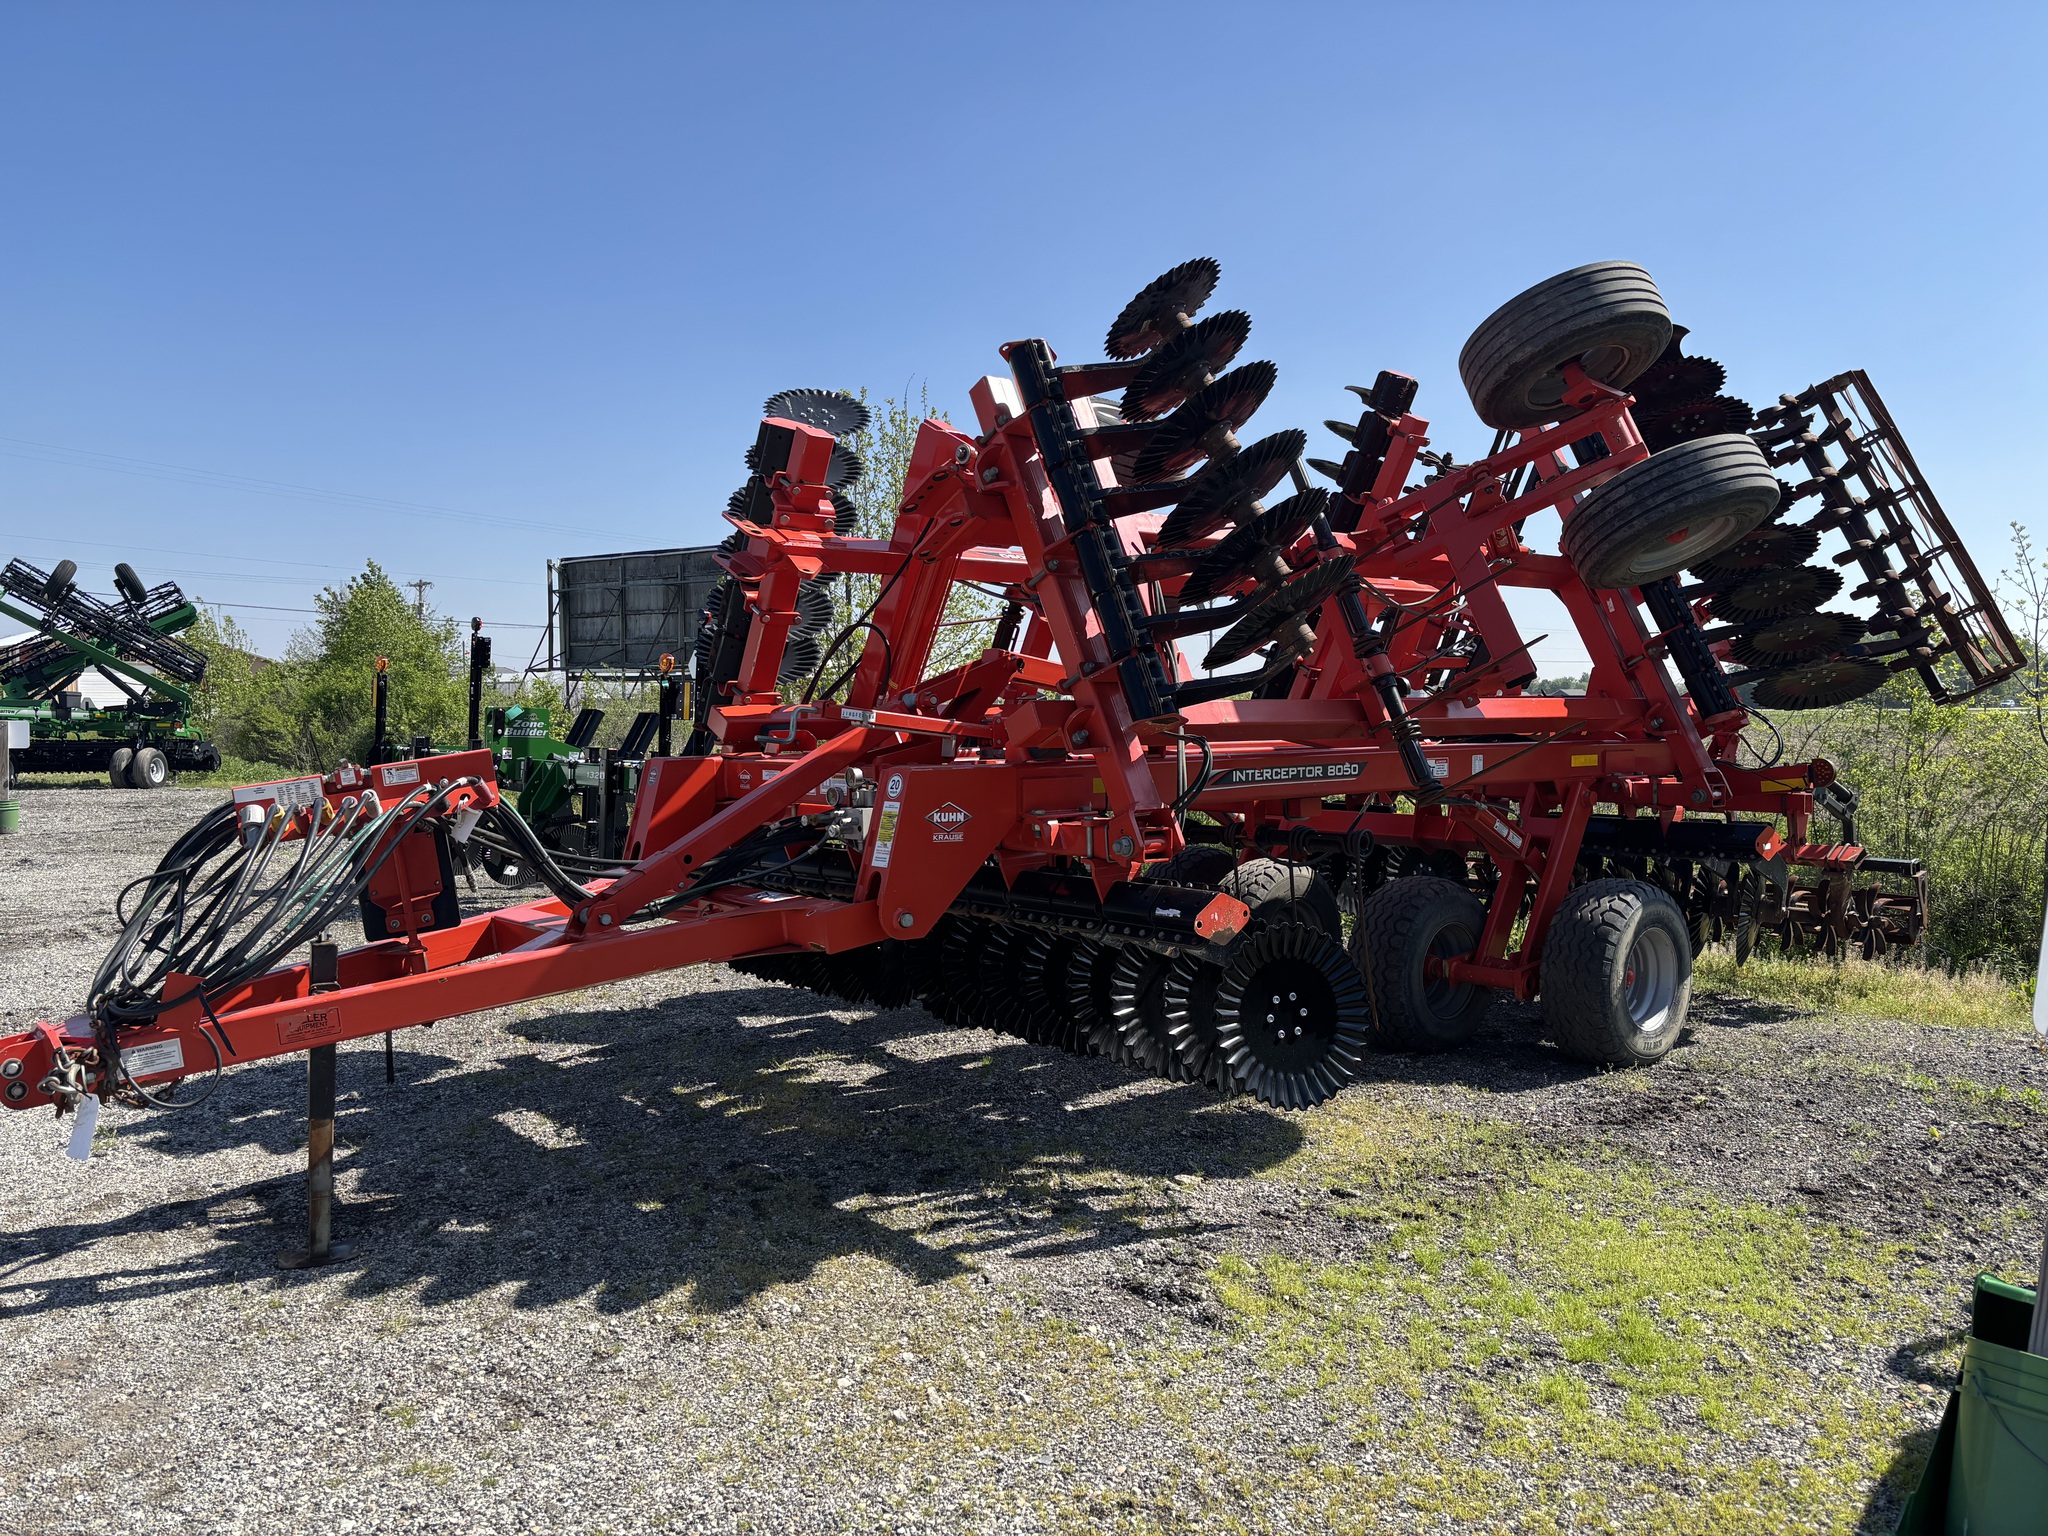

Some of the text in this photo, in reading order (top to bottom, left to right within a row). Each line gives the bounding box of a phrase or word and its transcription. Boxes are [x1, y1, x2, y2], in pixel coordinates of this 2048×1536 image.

[504, 728, 548, 737] Builder
[1233, 763, 1358, 782] INTERCEPTOR 8050
[889, 779, 900, 791] 20
[933, 812, 965, 822] KUHN
[137, 1043, 163, 1053] WARNING
